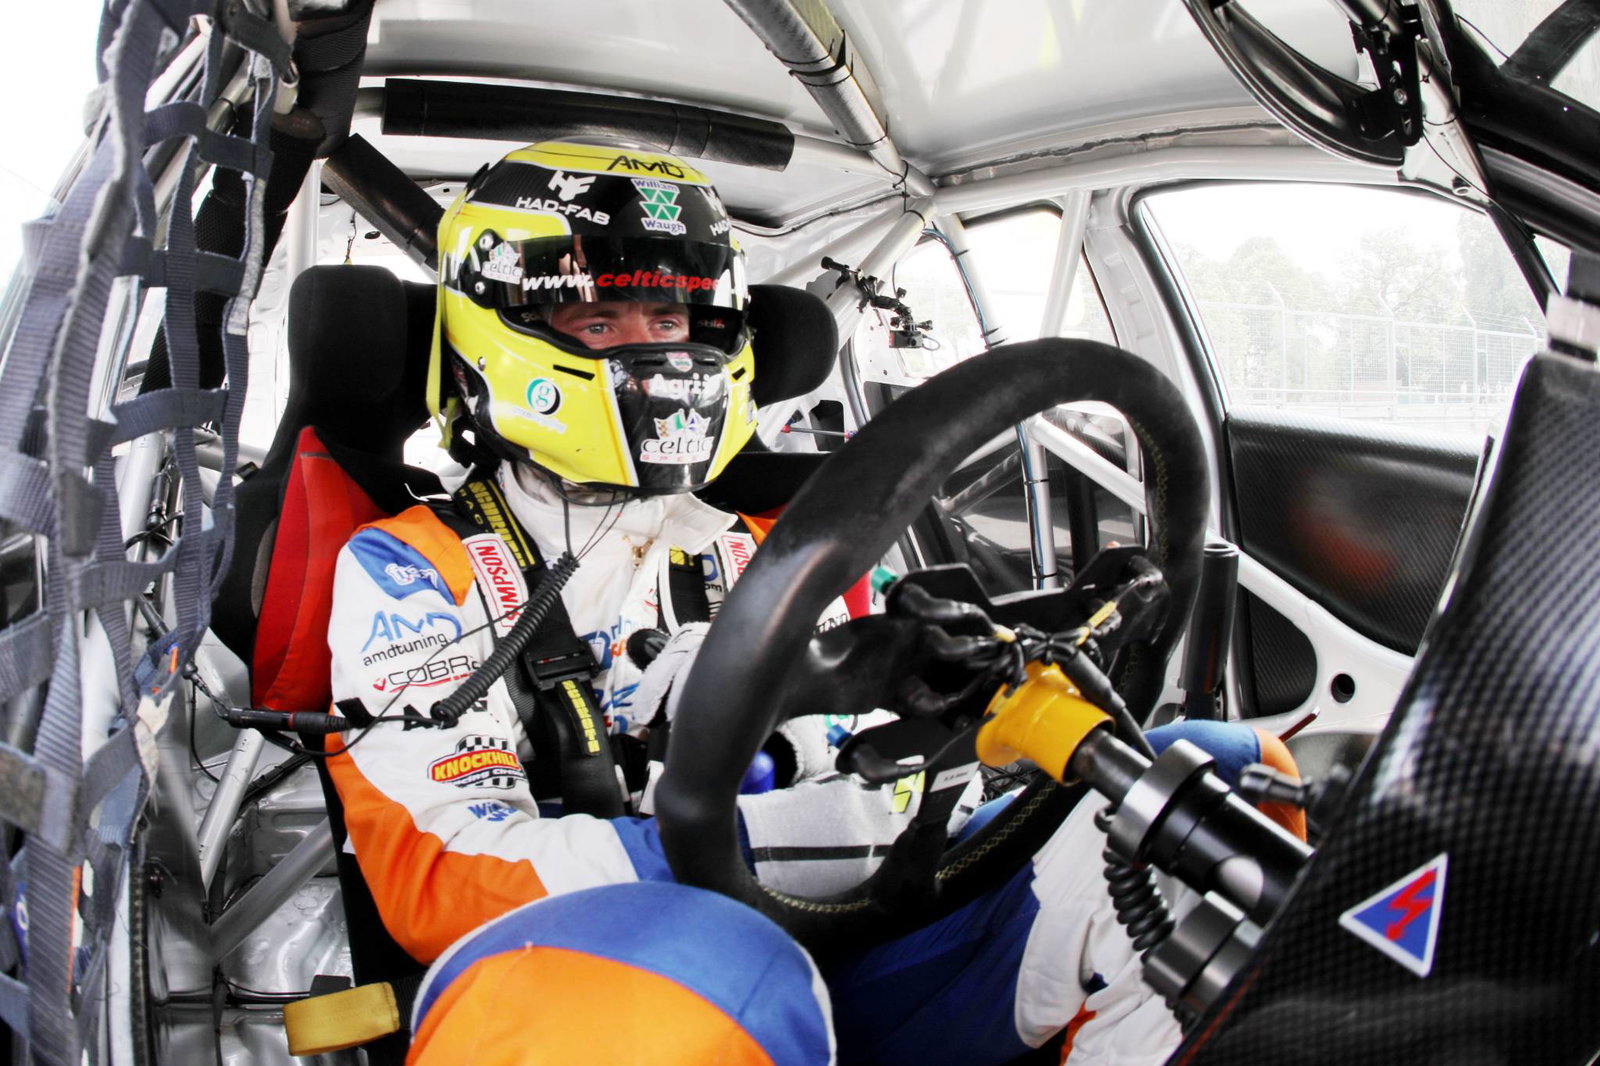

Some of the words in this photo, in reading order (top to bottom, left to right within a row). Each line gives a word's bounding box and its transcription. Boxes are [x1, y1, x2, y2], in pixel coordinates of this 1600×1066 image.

[606, 155, 686, 179] AMD
[633, 179, 679, 192] William
[515, 196, 611, 226] HAD-FAB
[644, 219, 685, 235] Waugh
[475, 545, 522, 622] SIMPSON
[361, 609, 463, 654] AMD
[363, 631, 450, 667] amdtuning
[434, 750, 520, 781] KNOCKHILL
